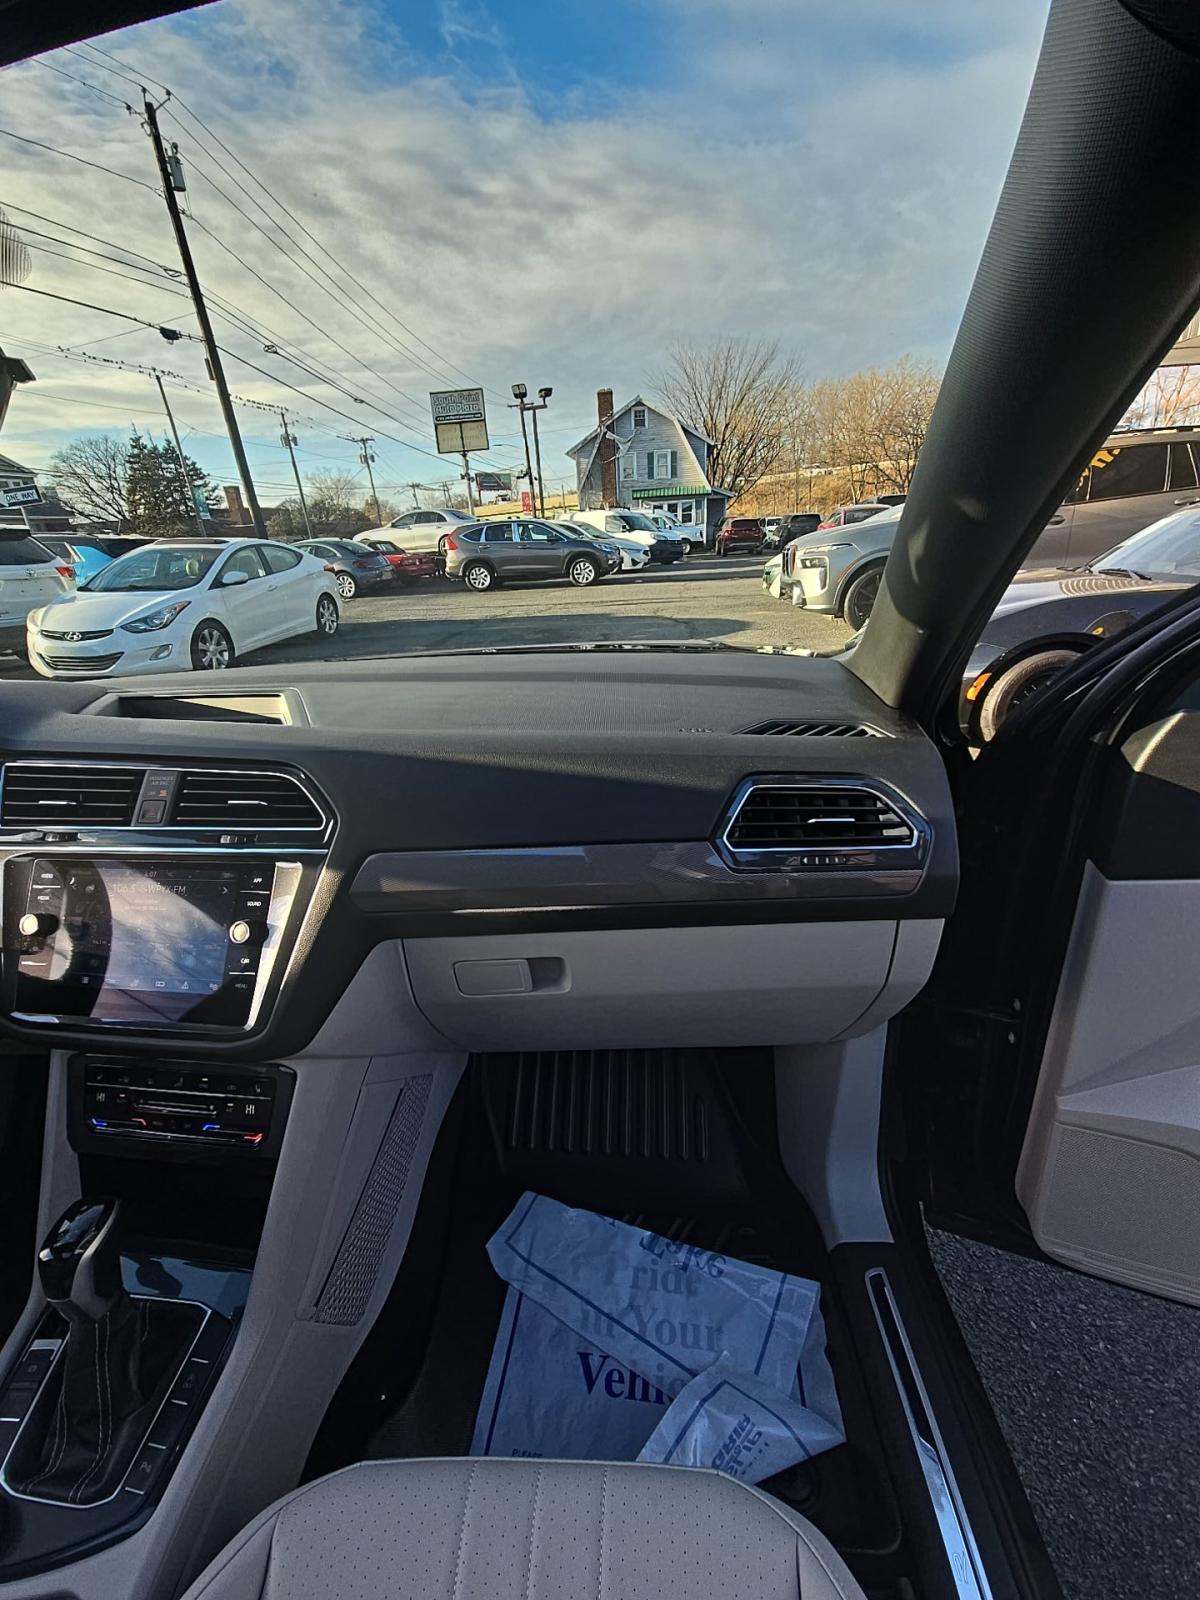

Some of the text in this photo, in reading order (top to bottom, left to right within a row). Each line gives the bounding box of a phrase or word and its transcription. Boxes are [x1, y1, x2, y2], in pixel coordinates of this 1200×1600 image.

[433, 392, 481, 405] South Point
[435, 403, 456, 414] Auto
[5, 490, 35, 502] ONE WAY
[245, 1104, 255, 1115] HI
